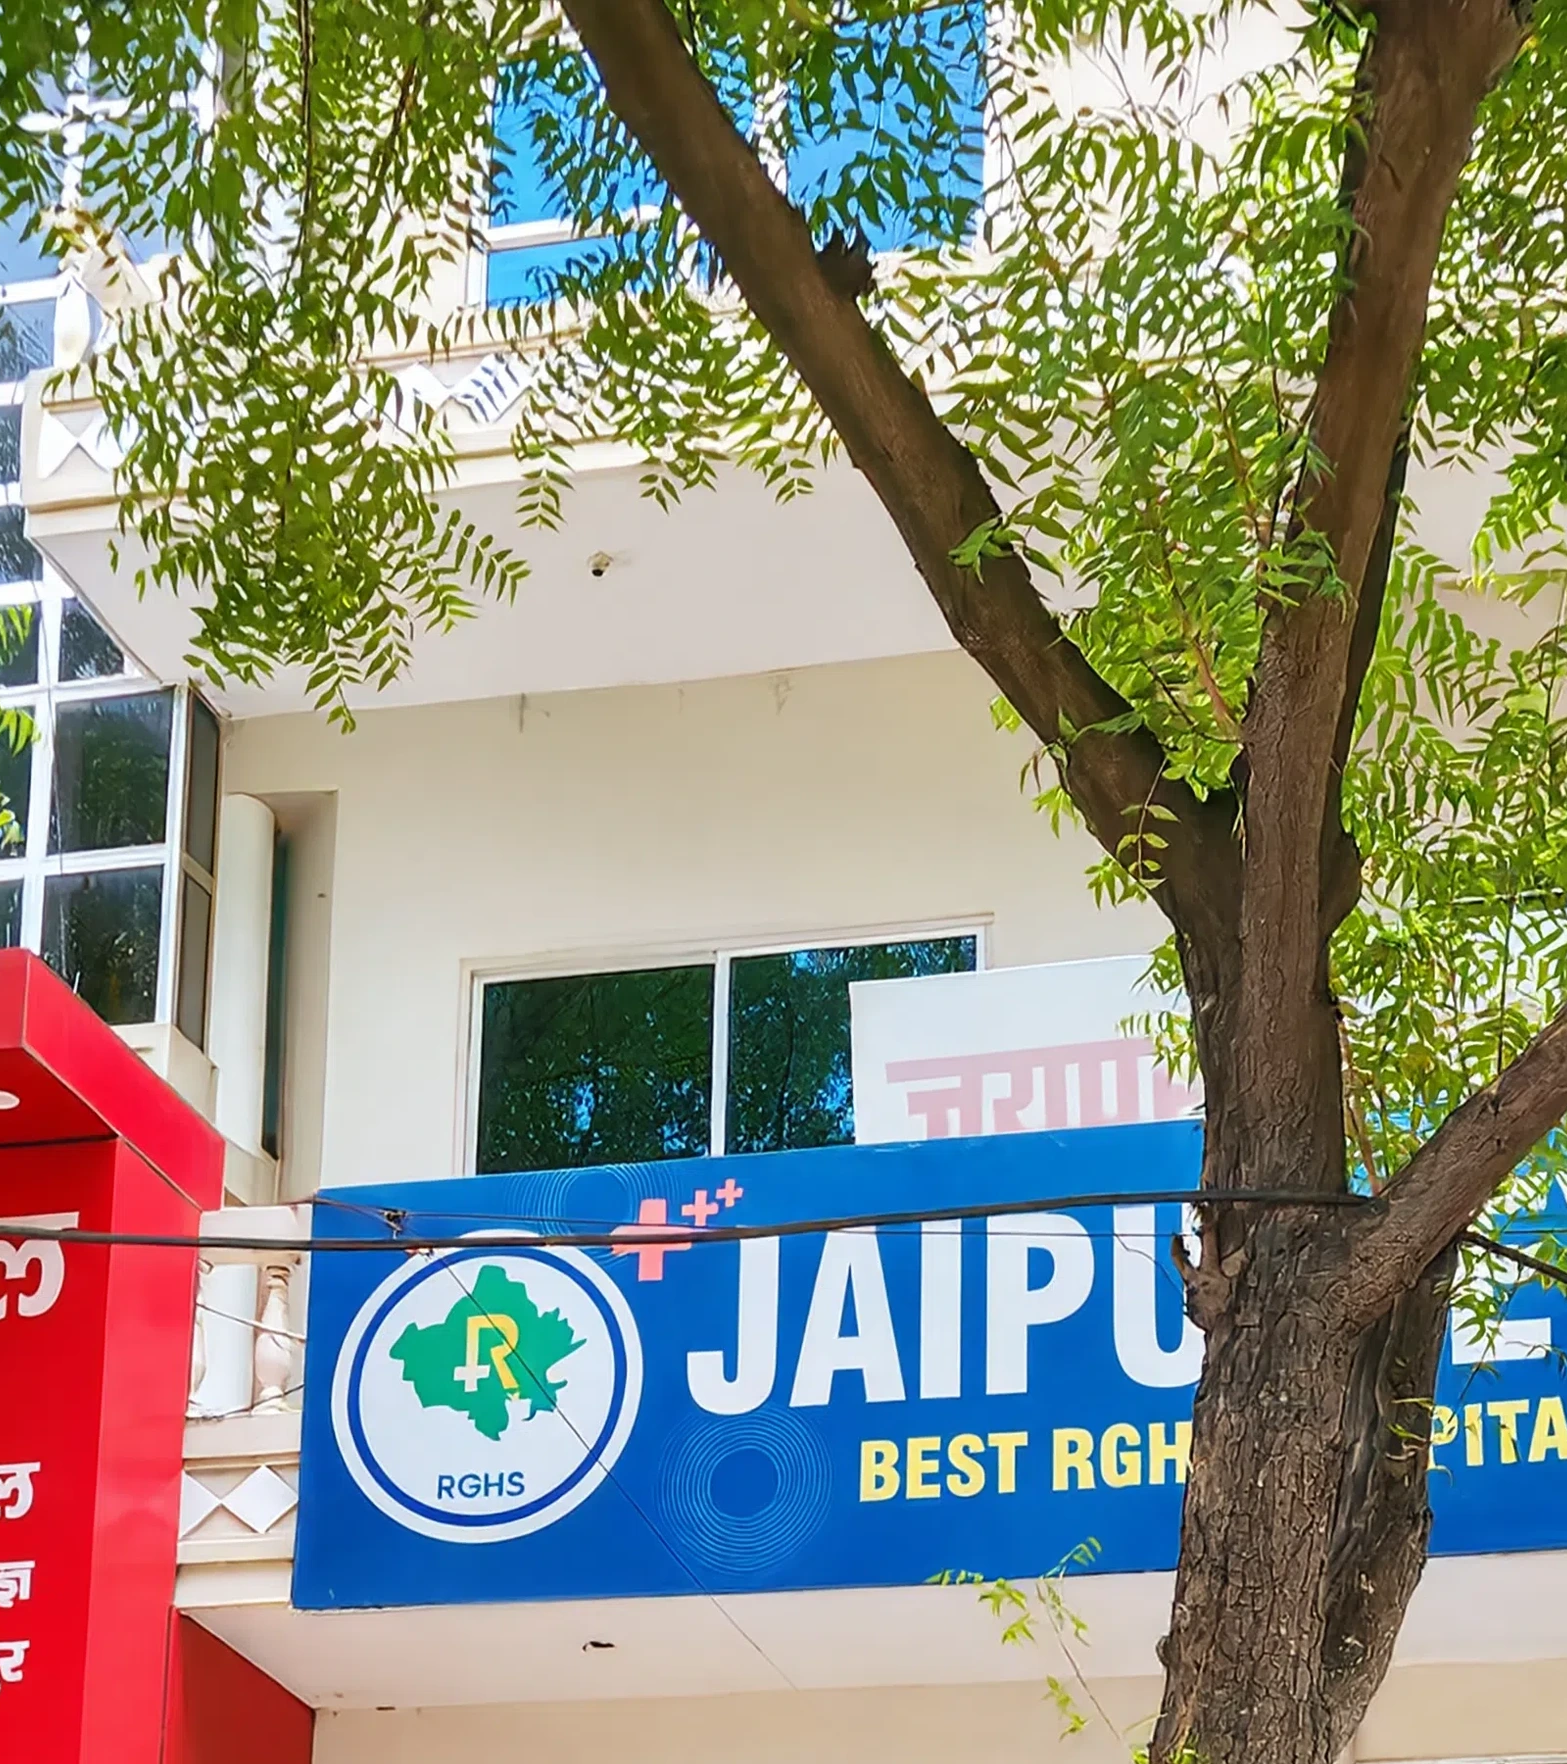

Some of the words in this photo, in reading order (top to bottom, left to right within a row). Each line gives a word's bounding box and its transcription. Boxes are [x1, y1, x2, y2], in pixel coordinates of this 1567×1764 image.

[687, 1200, 1206, 1416] JAIPU
[437, 1471, 526, 1500] RGHS
[859, 1431, 1028, 1503] BEST
[1052, 1421, 1192, 1491] RGH
